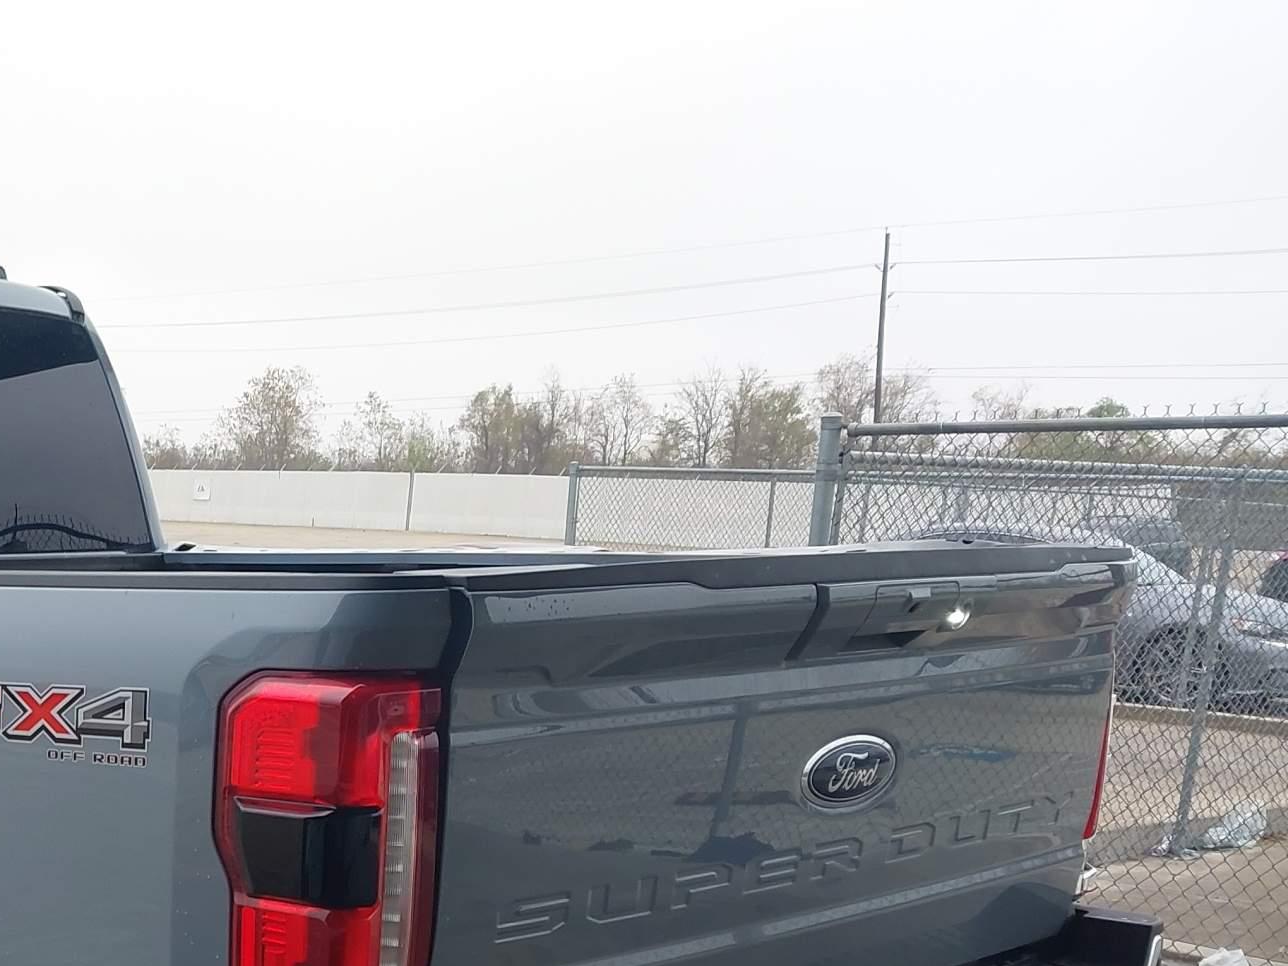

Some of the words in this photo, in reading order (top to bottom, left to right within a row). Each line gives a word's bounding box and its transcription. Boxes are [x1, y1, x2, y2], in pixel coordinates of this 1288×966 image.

[47, 749, 85, 762] OFF
[92, 751, 148, 768] ROAD
[829, 752, 881, 793] Ford
[494, 836, 865, 944] SUPER
[887, 791, 1076, 862] DUTY
